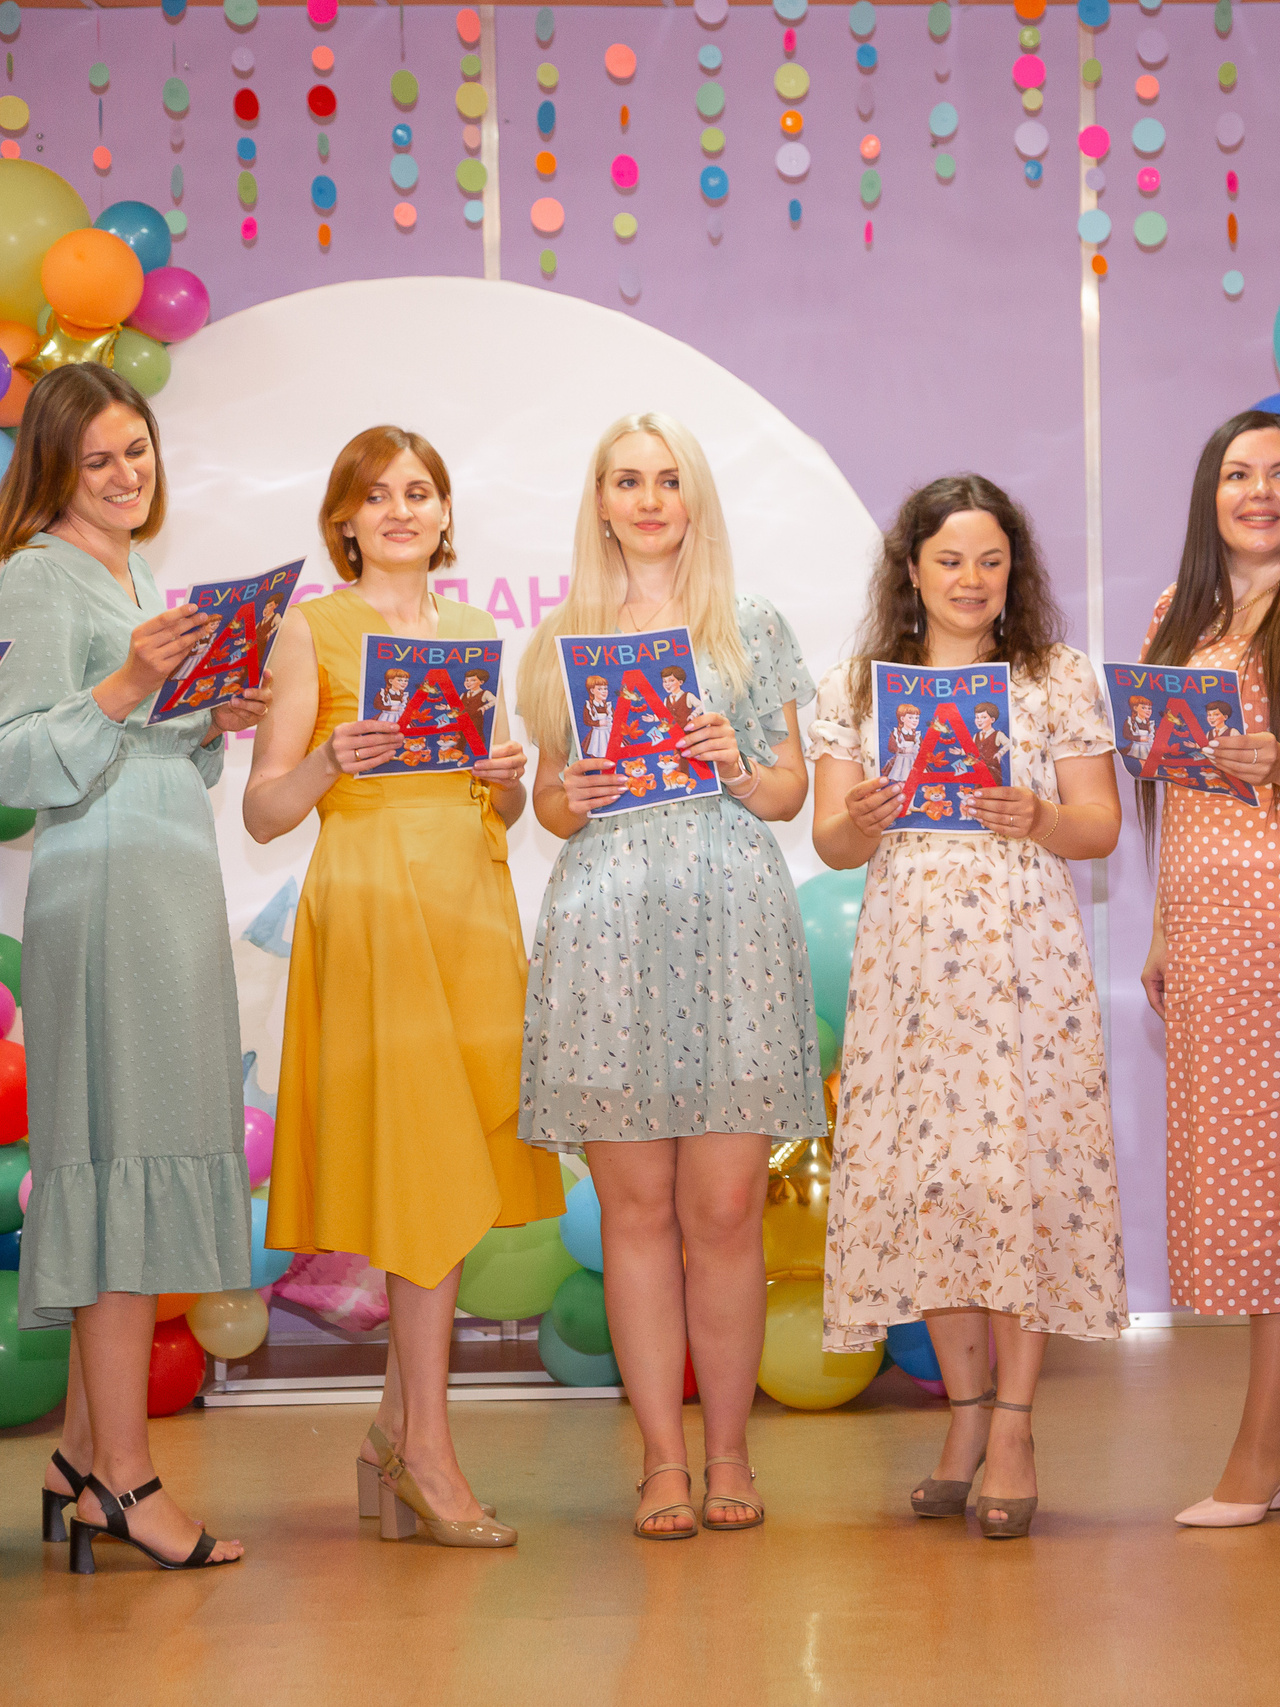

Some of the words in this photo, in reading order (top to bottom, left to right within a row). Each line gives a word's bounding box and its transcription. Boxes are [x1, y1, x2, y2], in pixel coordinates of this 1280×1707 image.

[197, 569, 298, 608] БУКВАРЬ
[377, 643, 499, 664] БУКВАРЬ
[572, 638, 689, 666] БУКВАРЬ
[887, 674, 1006, 698] БУКВАРЬ
[1115, 669, 1237, 694] БУКВАРЬ
